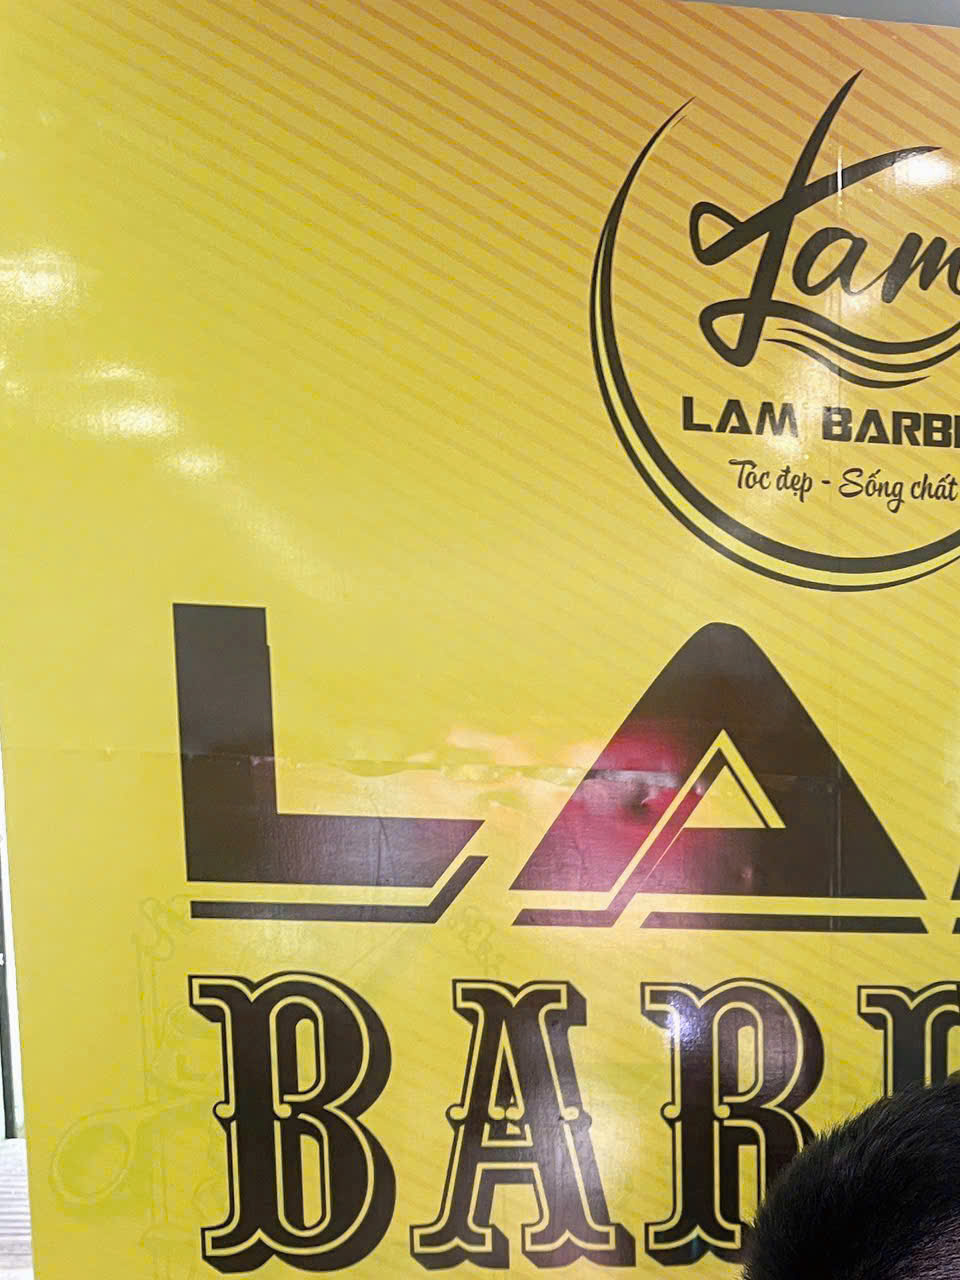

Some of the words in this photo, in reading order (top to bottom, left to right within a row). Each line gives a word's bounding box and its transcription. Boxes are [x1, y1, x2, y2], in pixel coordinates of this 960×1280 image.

[682, 395, 799, 438] LAM
[776, 465, 813, 503] đẹp
[838, 467, 905, 514] Sống
[910, 473, 959, 502] chất
